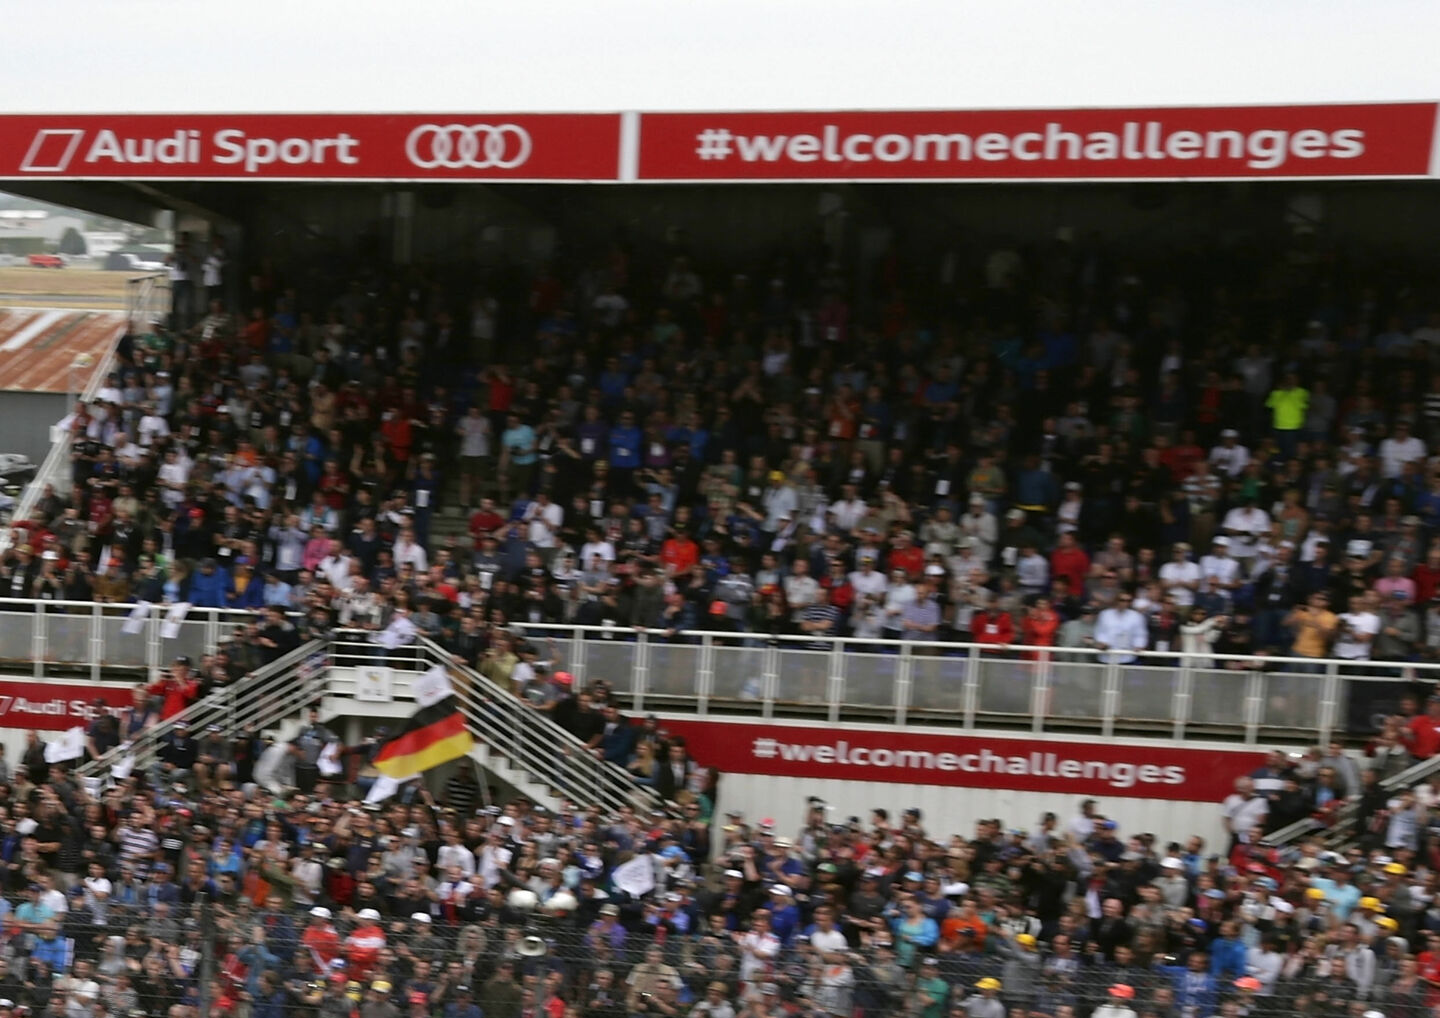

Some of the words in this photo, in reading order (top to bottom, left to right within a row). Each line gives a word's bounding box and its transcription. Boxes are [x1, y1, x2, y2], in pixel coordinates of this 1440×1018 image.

[85, 129, 201, 164] Audi
[212, 129, 360, 173] Sport
[695, 122, 1366, 169] #welcomechallenges
[10, 696, 67, 716] Audi
[752, 736, 1186, 788] #welcomechallenges
